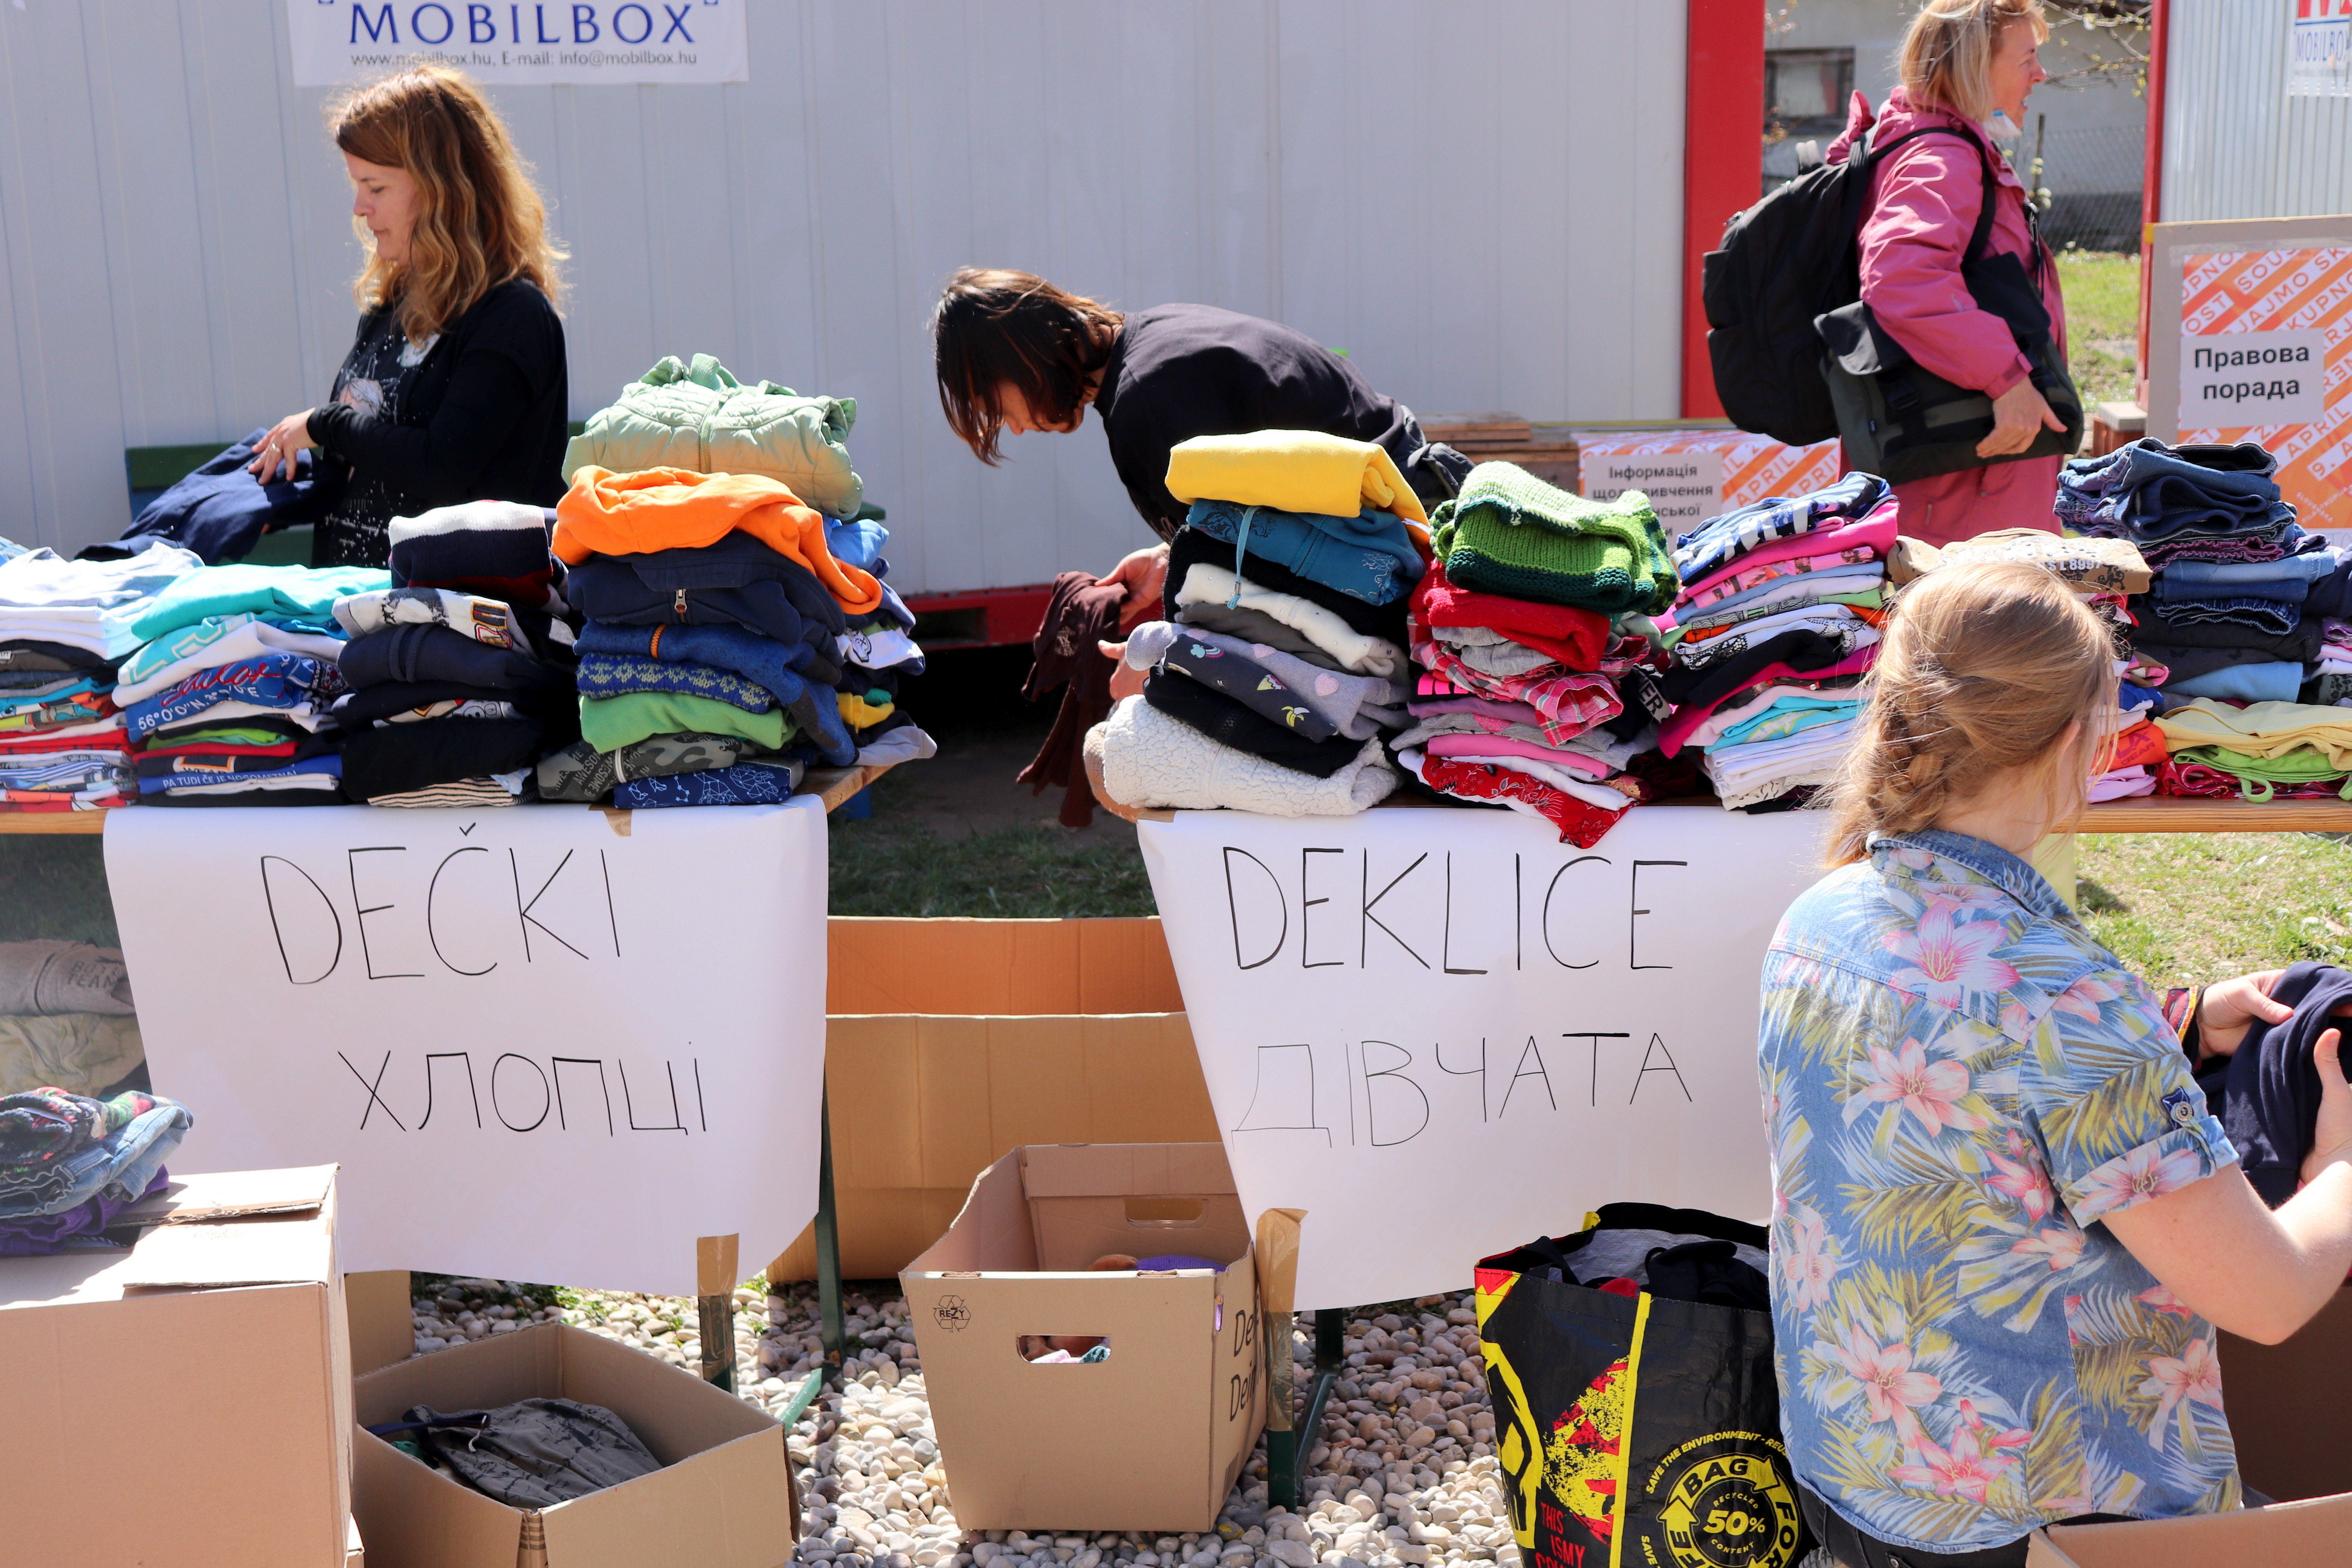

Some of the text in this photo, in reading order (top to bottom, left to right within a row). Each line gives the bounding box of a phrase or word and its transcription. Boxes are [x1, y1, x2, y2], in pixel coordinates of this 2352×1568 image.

[350, 3, 695, 44] MOBILBOX
[502, 51, 554, 64] E-mail:
[560, 50, 697, 66] info@mobilbox.hu
[2223, 272, 2310, 334] JAJMO
[2195, 346, 2310, 372] Правова
[2203, 379, 2301, 403] порада
[1609, 463, 1697, 481] Інформація
[1737, 456, 1796, 508] APRIL
[163, 780, 177, 789] PA
[177, 776, 201, 786] TUDI
[202, 774, 214, 784] ČE
[261, 822, 621, 985] DEČKI
[1223, 846, 1688, 975] DEKLICE
[338, 1042, 707, 1138] ХЛОПЦІ
[1231, 1032, 1693, 1149] ДІВЧАТА
[1646, 1465, 1665, 1494] SAVE
[1661, 1448, 1682, 1467] THE
[1681, 1430, 1762, 1453] ENVIRONMENT
[1682, 1458, 1748, 1499] BAG
[1713, 1492, 1759, 1509] RECYCLED
[1540, 1501, 1564, 1534] THIS
[1703, 1509, 1766, 1536] 50%
[1641, 1535, 1659, 1565] SAVE
[1711, 1539, 1754, 1554] CONTENT
